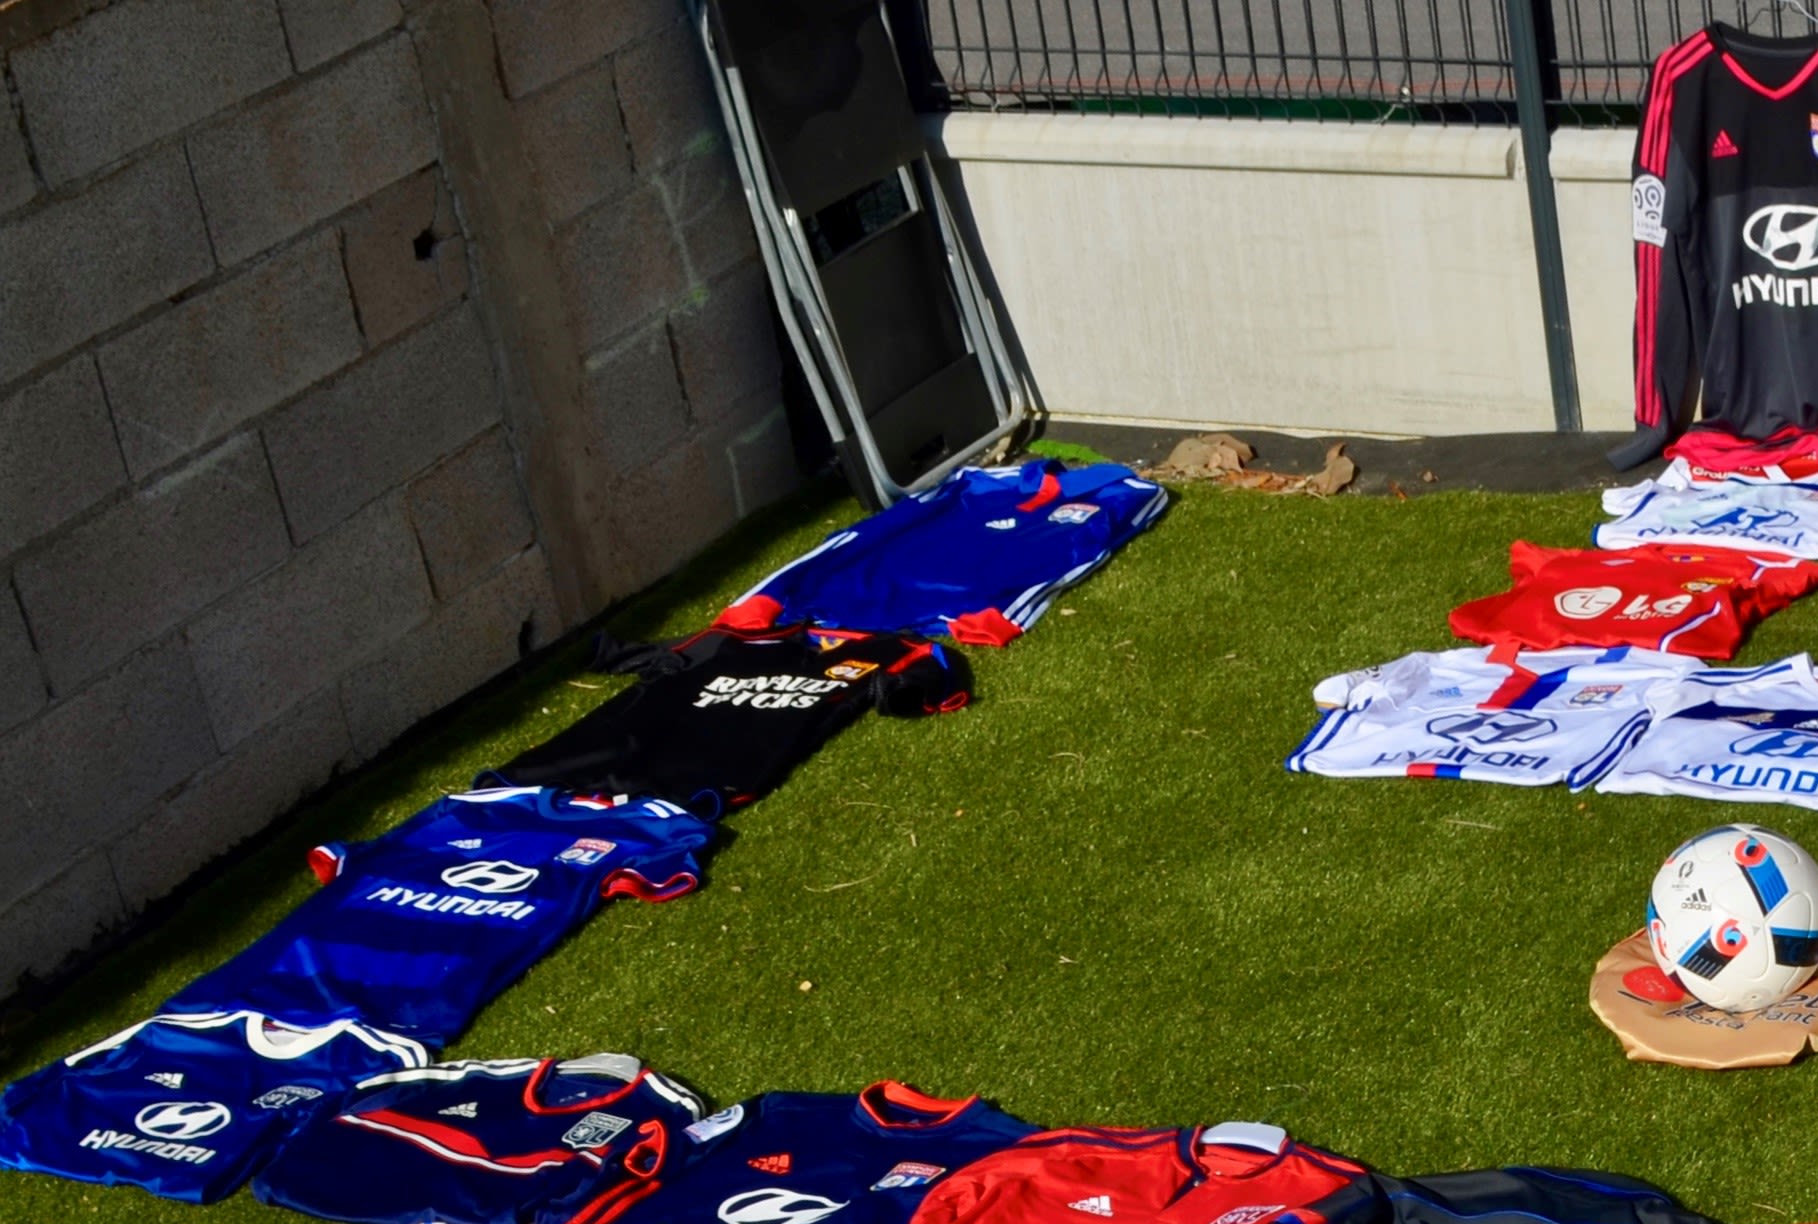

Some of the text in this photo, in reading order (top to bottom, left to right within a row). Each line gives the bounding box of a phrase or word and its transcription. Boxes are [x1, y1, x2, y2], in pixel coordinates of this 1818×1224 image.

[1622, 594, 1693, 615] LG
[368, 887, 534, 920] HYUNDAI
[79, 1128, 214, 1164] HYUNDAI
